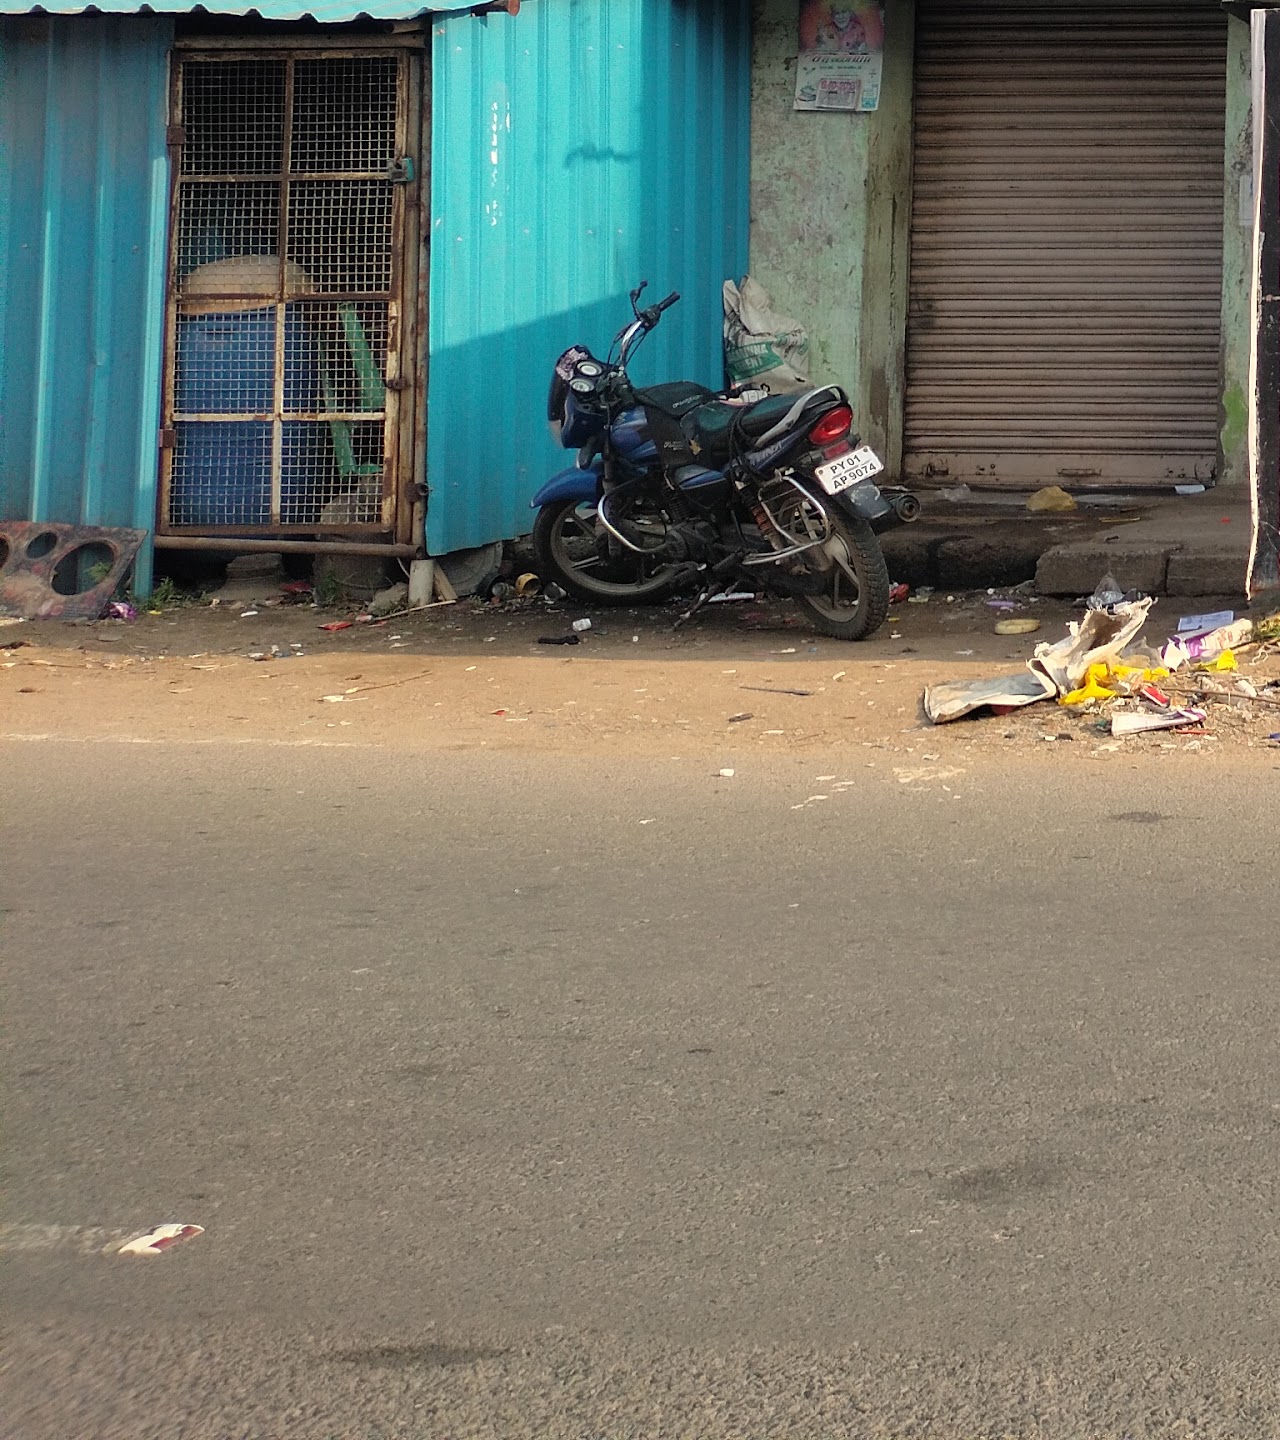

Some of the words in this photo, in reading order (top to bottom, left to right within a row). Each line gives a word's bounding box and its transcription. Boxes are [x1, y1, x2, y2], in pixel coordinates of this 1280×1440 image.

[830, 462, 846, 474] PY
[846, 454, 861, 466] 01
[833, 474, 848, 489] AP
[849, 462, 877, 480] 9074
